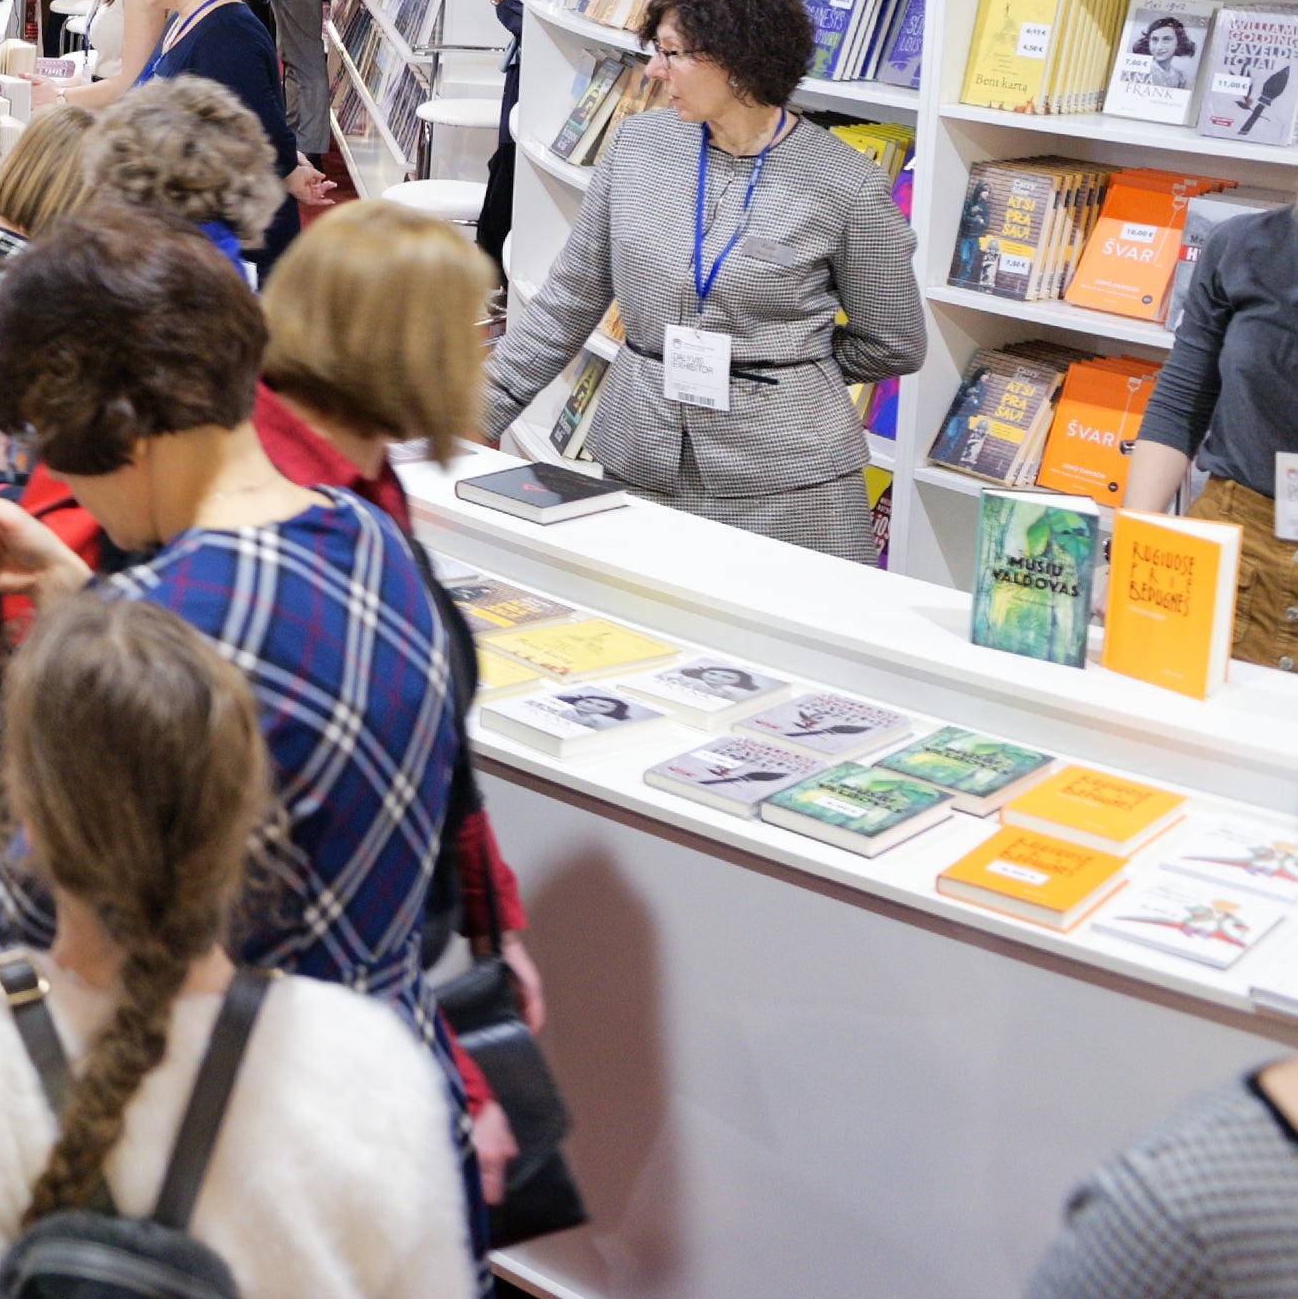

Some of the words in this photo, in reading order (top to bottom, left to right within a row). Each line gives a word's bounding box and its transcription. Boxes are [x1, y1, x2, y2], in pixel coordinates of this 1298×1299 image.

[976, 73, 1005, 88] Bent
[1122, 71, 1154, 84] ANA
[1217, 80, 1238, 89] 11,00
[1125, 83, 1174, 100] FRANK
[1008, 196, 1036, 210] ATSI
[1005, 210, 1031, 225] PRA
[1126, 228, 1148, 237] 10,00
[1006, 381, 1037, 397] ATSI
[1000, 395, 1027, 410] PRA
[993, 568, 1081, 598] VALDOVAS
